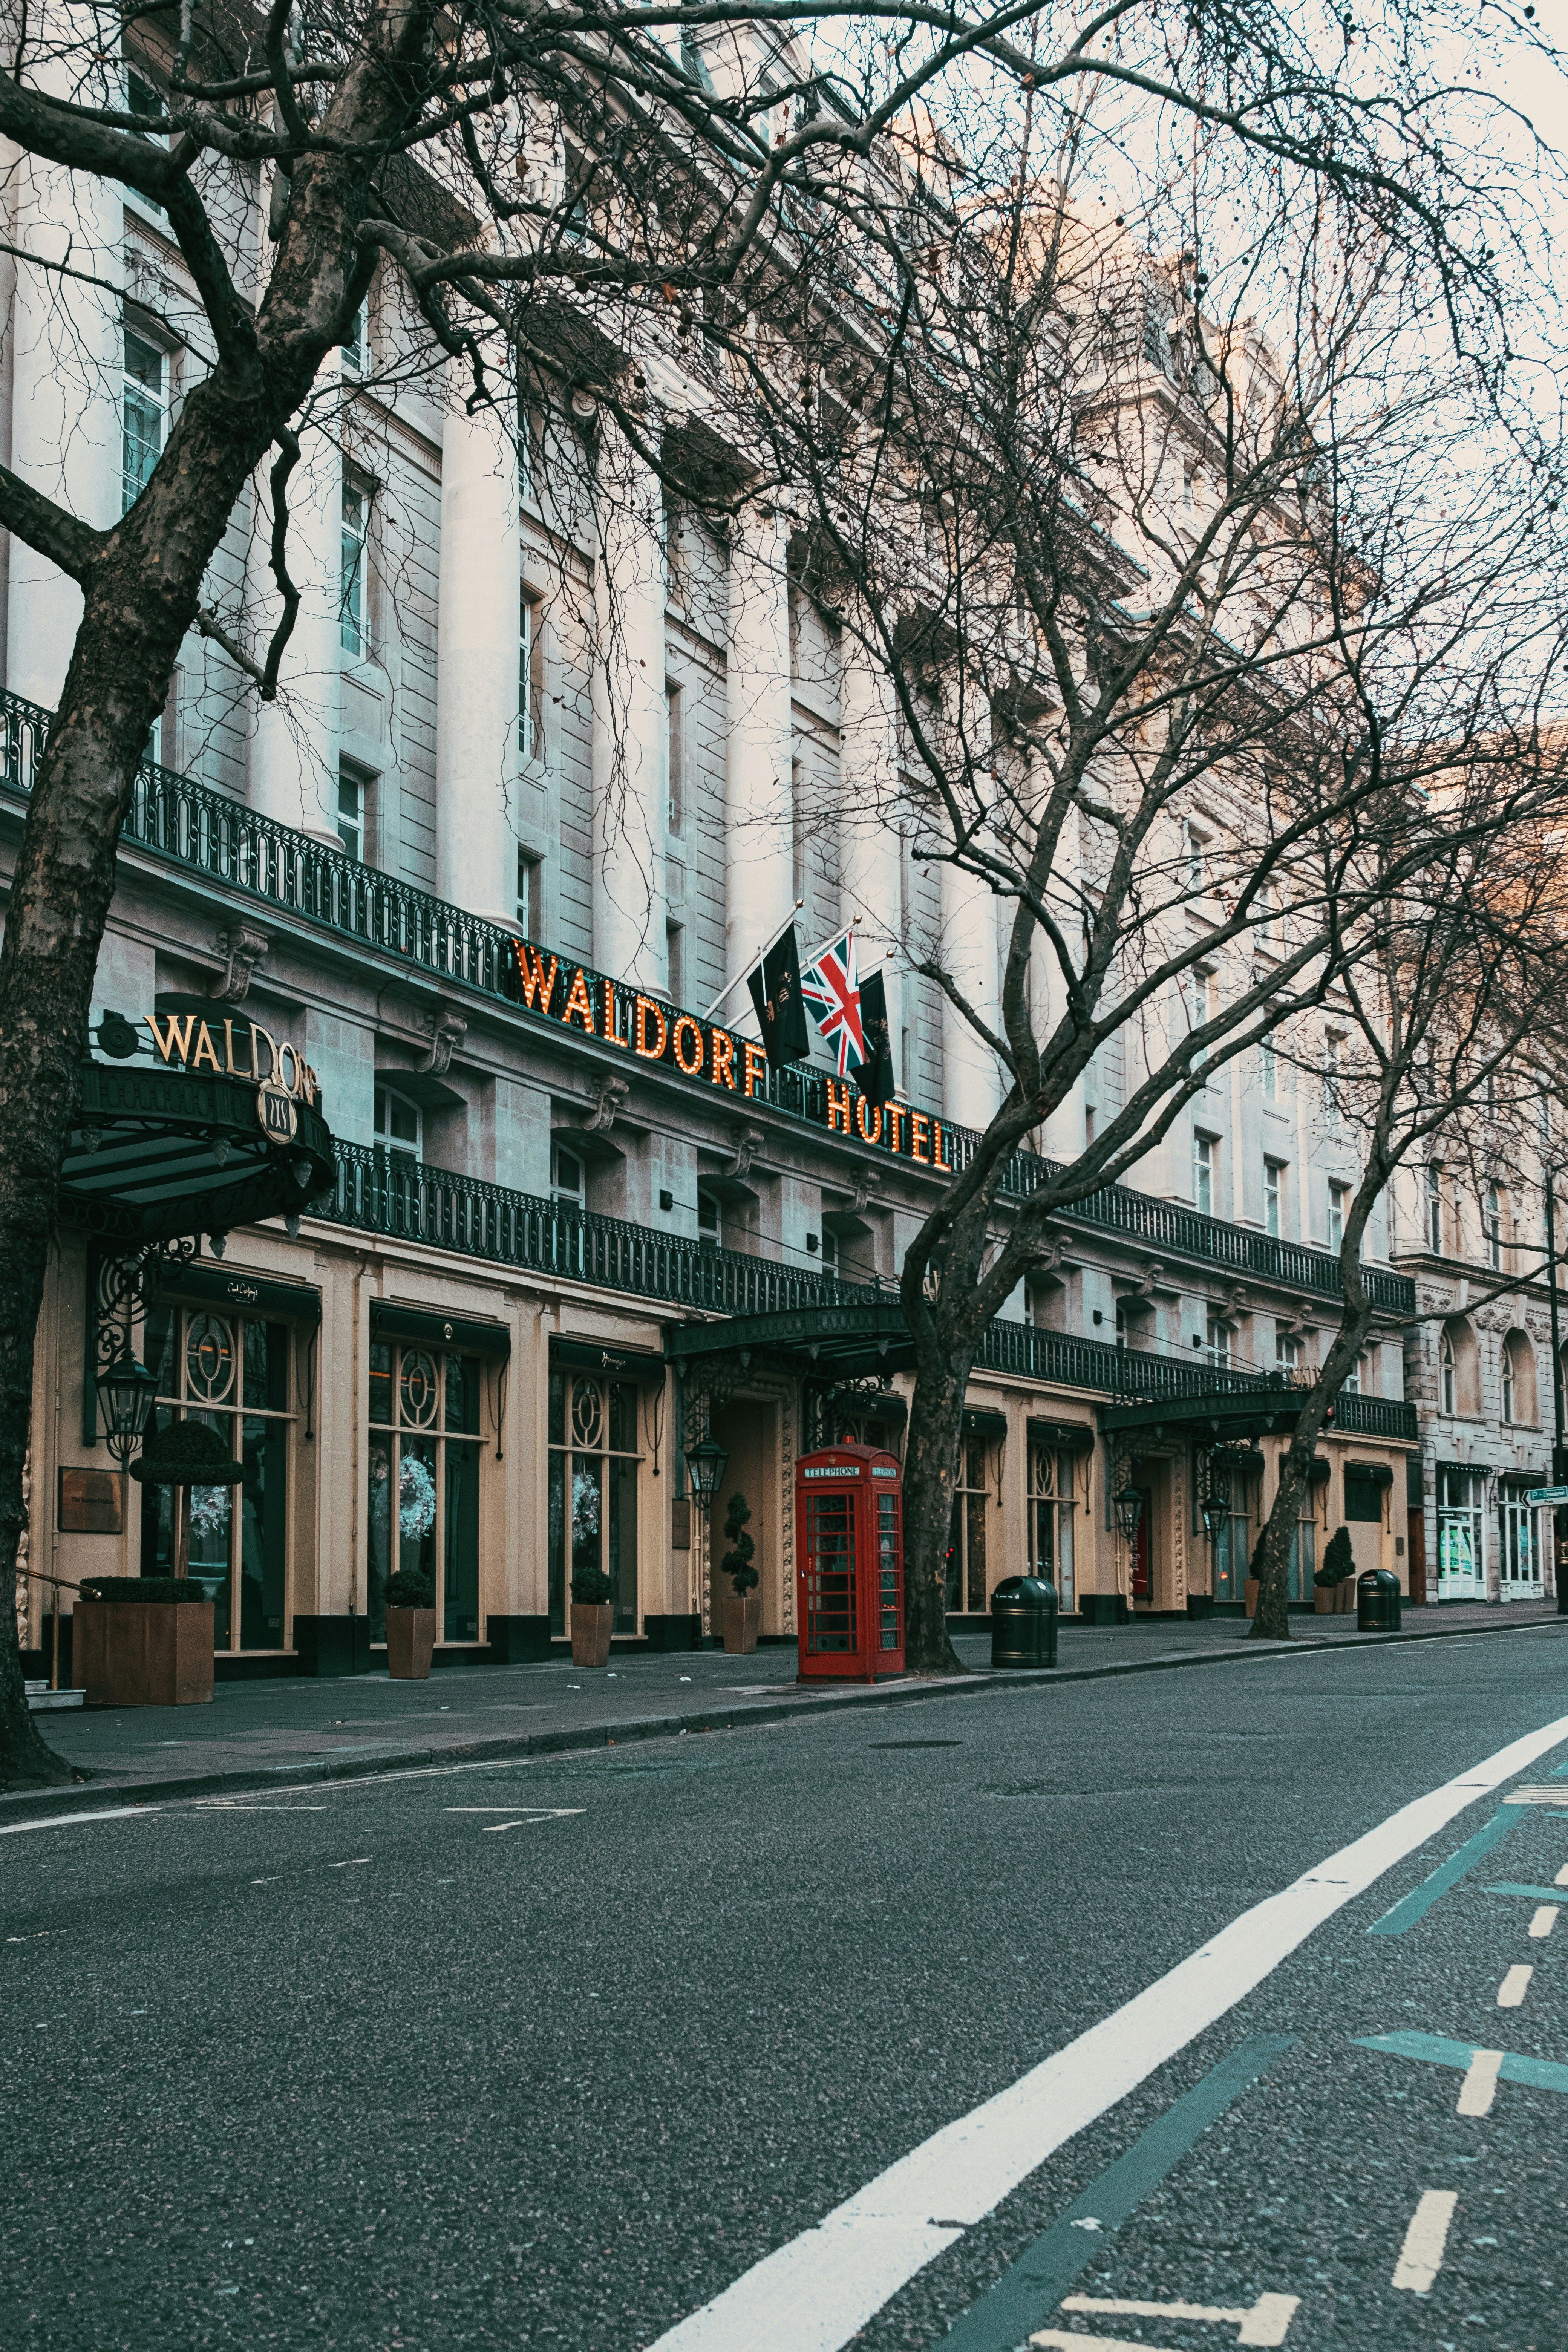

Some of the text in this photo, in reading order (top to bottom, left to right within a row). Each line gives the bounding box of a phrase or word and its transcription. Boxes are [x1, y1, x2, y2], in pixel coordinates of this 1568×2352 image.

[510, 939, 951, 1172] WALDORF HOTEL
[807, 1467, 859, 1477] TELEPHONE
